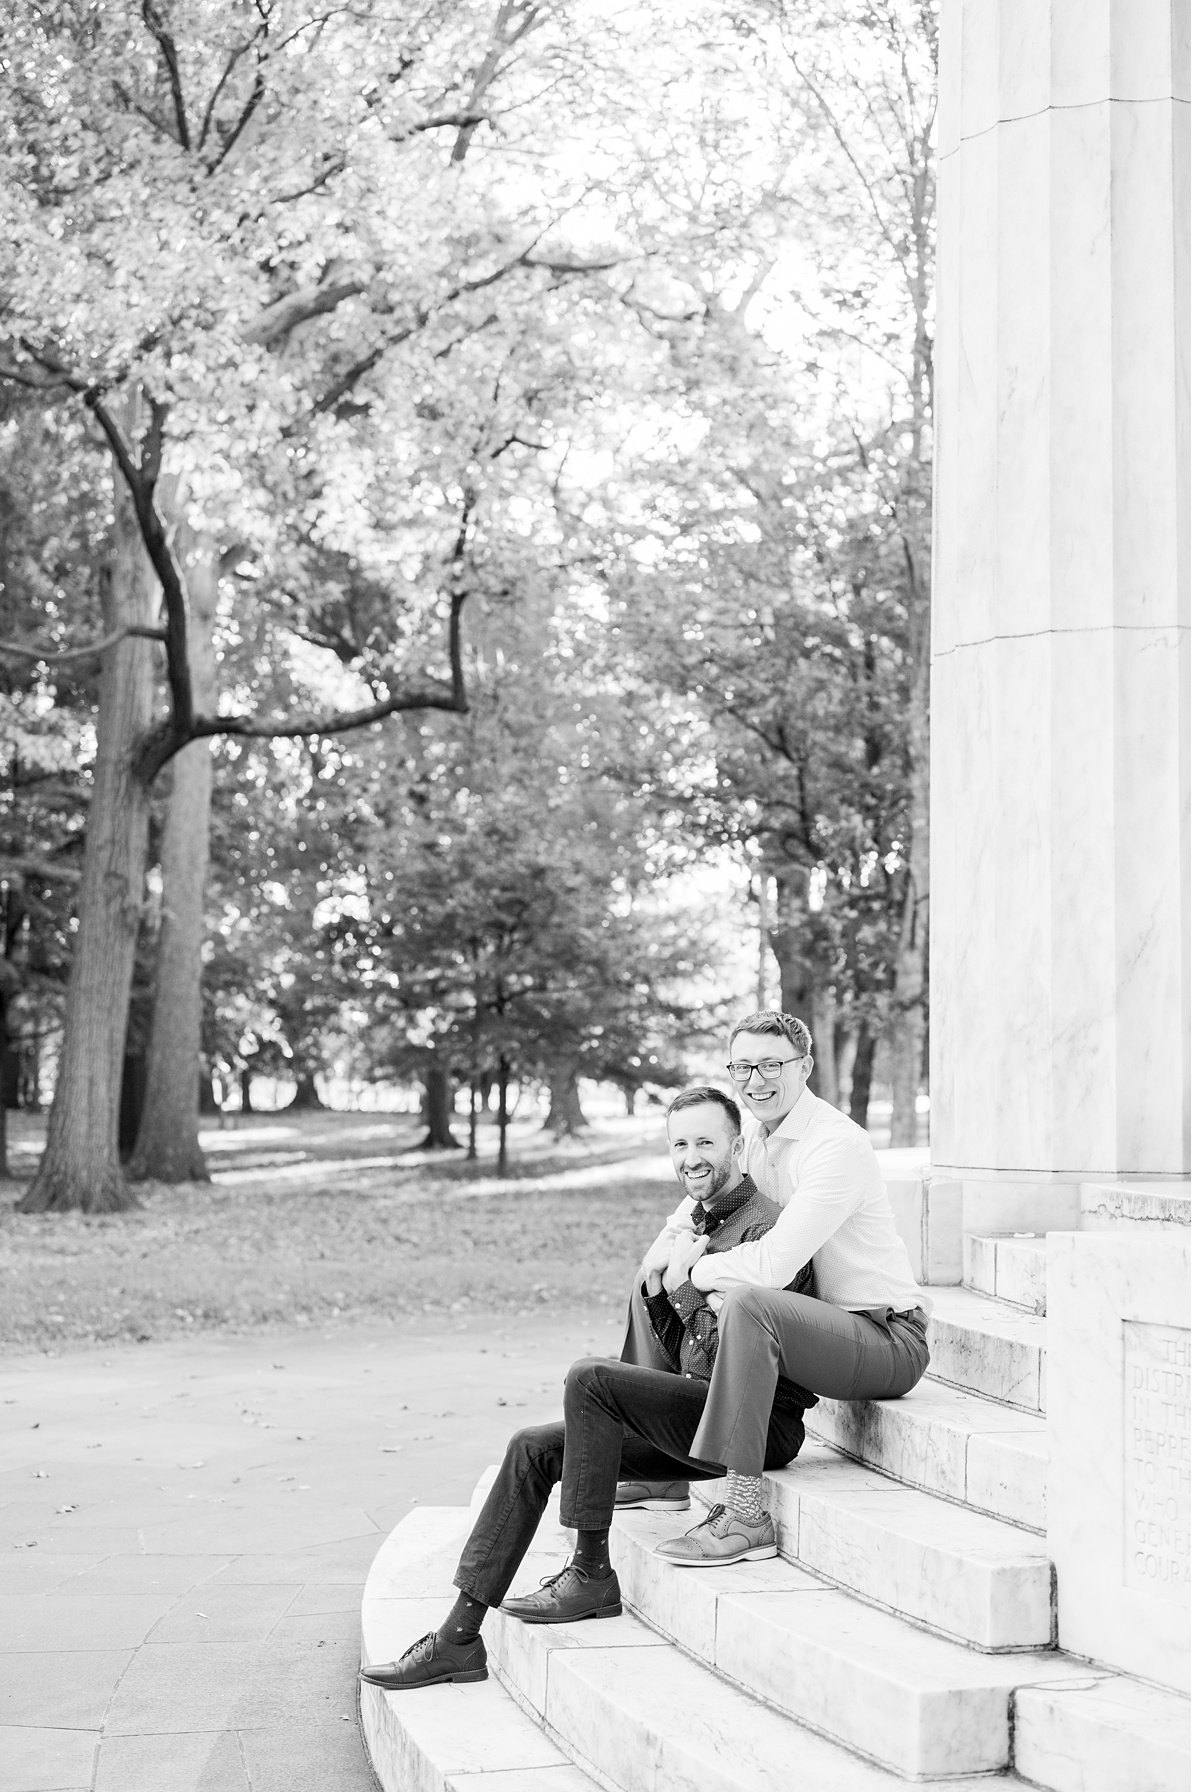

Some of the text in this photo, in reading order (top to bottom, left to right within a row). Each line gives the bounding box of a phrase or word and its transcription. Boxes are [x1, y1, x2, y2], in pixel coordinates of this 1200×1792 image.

[1132, 1396, 1191, 1431] IN TH
[1132, 1457, 1157, 1485] TO
[1134, 1488, 1179, 1522] WHO
